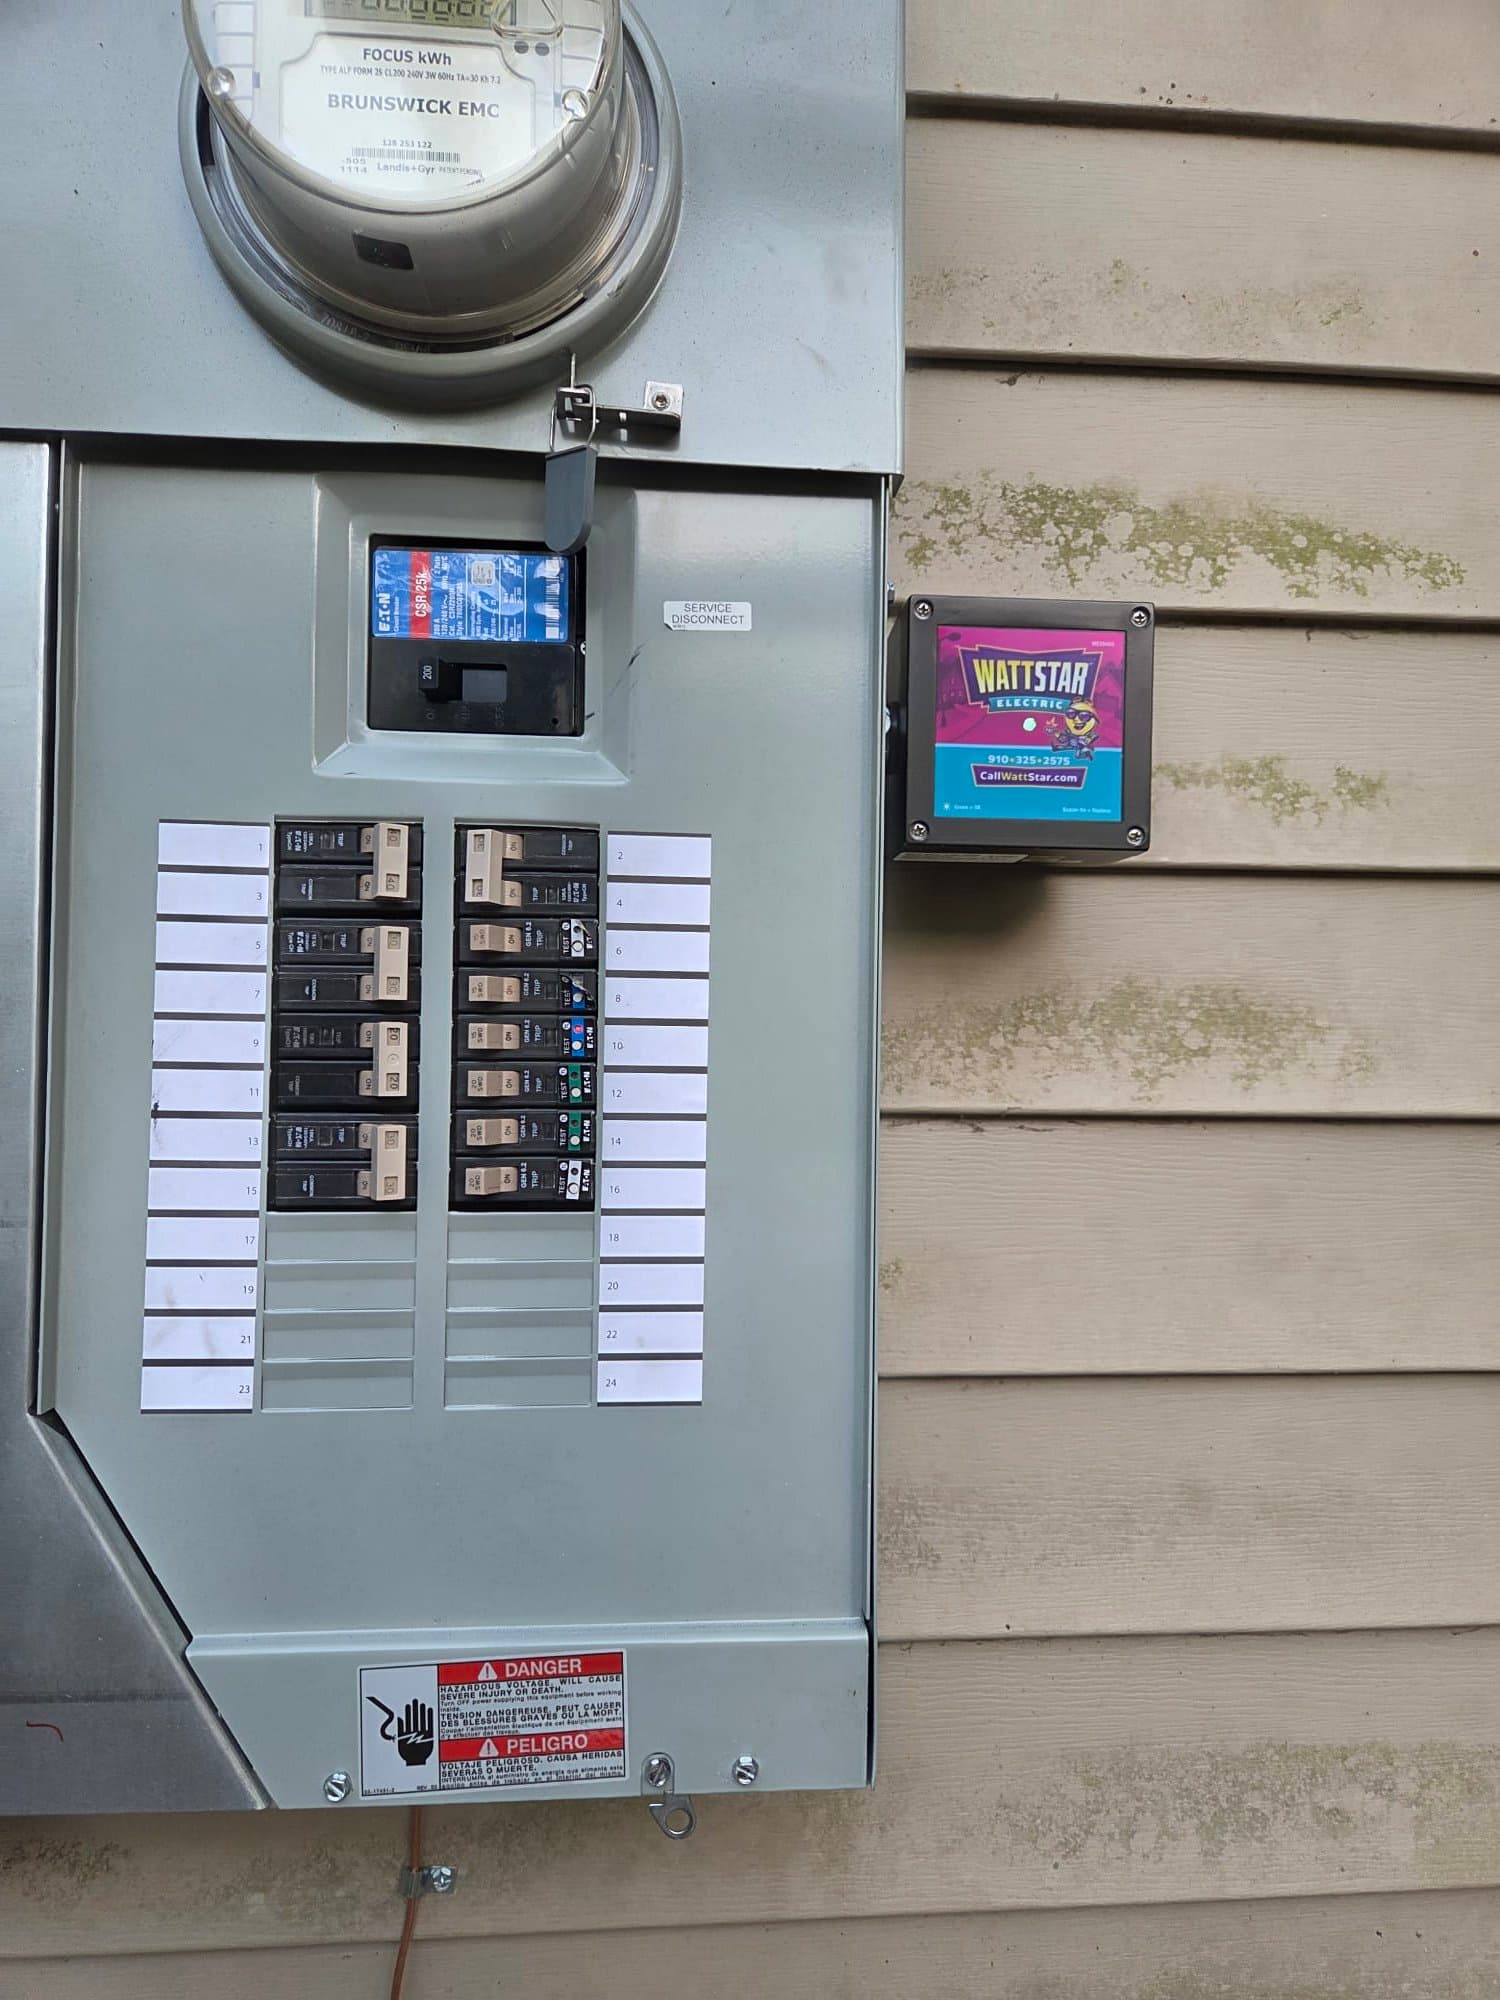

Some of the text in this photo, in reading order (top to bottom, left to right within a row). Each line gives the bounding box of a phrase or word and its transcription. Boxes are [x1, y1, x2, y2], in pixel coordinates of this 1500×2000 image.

[363, 48, 451, 65] FOCUS kWh
[353, 66, 373, 76] FORM
[384, 68, 405, 78] CL200
[407, 69, 423, 79] 240V
[425, 71, 436, 80] 3W
[437, 71, 454, 81] 60Hz
[327, 93, 500, 118] BRUNSWICK EMC
[417, 140, 433, 149] 122
[377, 162, 436, 175] Landis+Gyr
[415, 595, 427, 617] CSR
[684, 603, 732, 613] SERVICE
[672, 614, 744, 625] DISCONNECT
[422, 665, 432, 680] 200
[973, 658, 1089, 695] WATTSTAR
[997, 698, 1063, 710] ELECTRIC
[980, 771, 1077, 783] CallWattStar.com
[258, 843, 263, 852] 1
[617, 851, 623, 860] 2
[256, 892, 262, 901] 3
[616, 899, 623, 907] 4
[508, 934, 515, 944] ON
[255, 941, 261, 950] 5
[616, 946, 622, 955] 6
[254, 990, 260, 998] 7
[615, 994, 621, 1002] 8
[366, 1030, 372, 1042] ON
[505, 1031, 512, 1042] ON
[253, 1039, 259, 1047] 9
[612, 1042, 624, 1050] 10
[366, 1078, 372, 1090] ON
[390, 1076, 398, 1090] 20
[506, 1078, 513, 1089] ON
[249, 1088, 259, 1096] 11
[611, 1089, 622, 1097] 12
[504, 1125, 511, 1136] ON
[248, 1137, 259, 1146] 13
[610, 1137, 621, 1146] 14
[503, 1173, 511, 1184] ON
[531, 1170, 539, 1188] TRIP
[246, 1187, 257, 1195] 15
[609, 1185, 620, 1194] 16
[244, 1236, 255, 1244] 17
[608, 1233, 619, 1242] 18
[243, 1285, 254, 1294] 19
[607, 1282, 618, 1290] 20
[240, 1335, 251, 1344] 21
[606, 1330, 617, 1339] 22
[605, 1379, 616, 1387] 24
[239, 1385, 250, 1393] 23
[505, 1658, 582, 1678] DANGER
[441, 1683, 501, 1693] HAZARDOUS
[560, 1677, 583, 1685] WILL
[588, 1675, 620, 1683] CAUSE
[441, 1692, 475, 1700] SEVERE
[479, 1689, 512, 1698] INJURY
[532, 1686, 563, 1695] DEATH.
[441, 1711, 481, 1720] TENSION
[556, 1704, 579, 1712] PEUT
[584, 1701, 621, 1710] CAUSER
[463, 1715, 516, 1726] BLESSURES
[521, 1713, 557, 1722] GRAVES
[593, 1709, 622, 1717] MORT.
[507, 1734, 588, 1754] PELIGRO
[442, 1761, 482, 1770] VOLTAJE
[547, 1754, 578, 1762] CAUSA
[582, 1751, 622, 1759] HERIDAS
[442, 1768, 483, 1777] SEVERAS
[496, 1765, 536, 1773] MUERTE.
